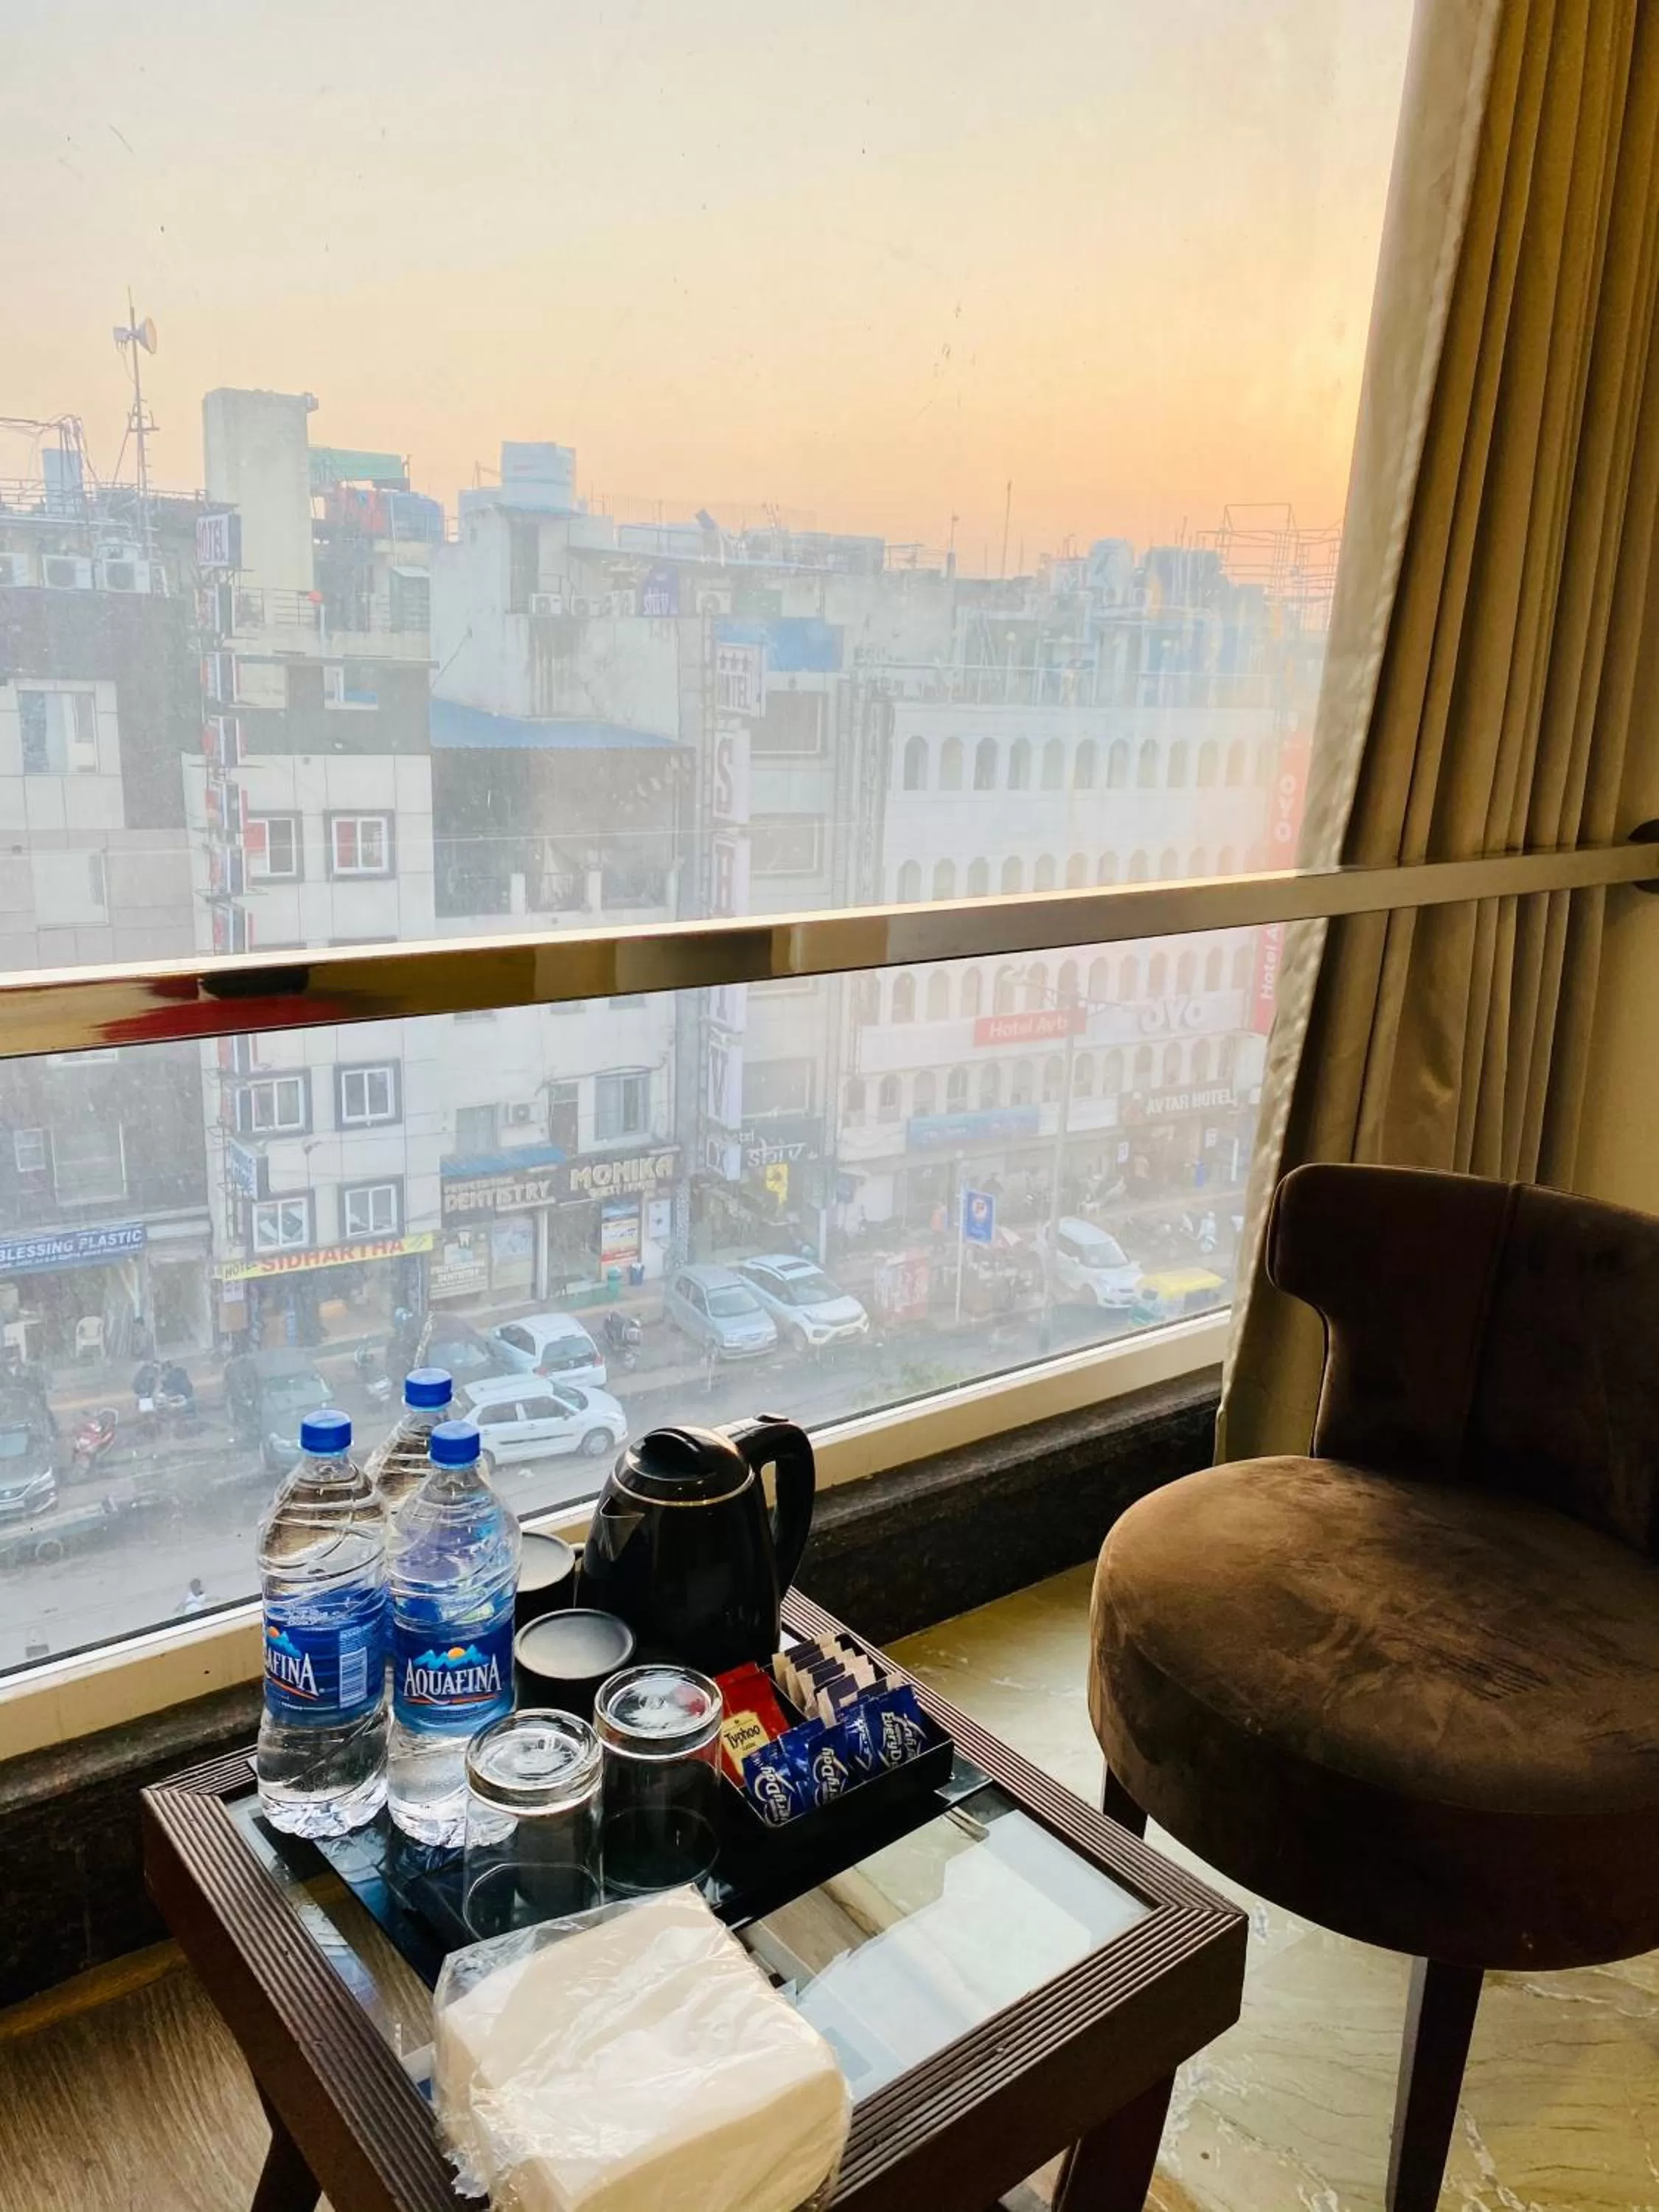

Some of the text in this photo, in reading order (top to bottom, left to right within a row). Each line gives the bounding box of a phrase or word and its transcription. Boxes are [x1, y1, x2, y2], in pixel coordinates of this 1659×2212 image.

[1274, 773, 1296, 842] OYO
[1261, 945, 1277, 1000] Hotel
[989, 1017, 1033, 1038] Hotel
[1139, 994, 1205, 1032] OYO
[570, 1155, 674, 1192] MONIKA
[445, 1180, 551, 1213] DENTISTRY
[78, 1229, 142, 1251] PLASTIC
[403, 1653, 501, 1705] AQUAFINA
[723, 1725, 760, 1750] Typhoo
